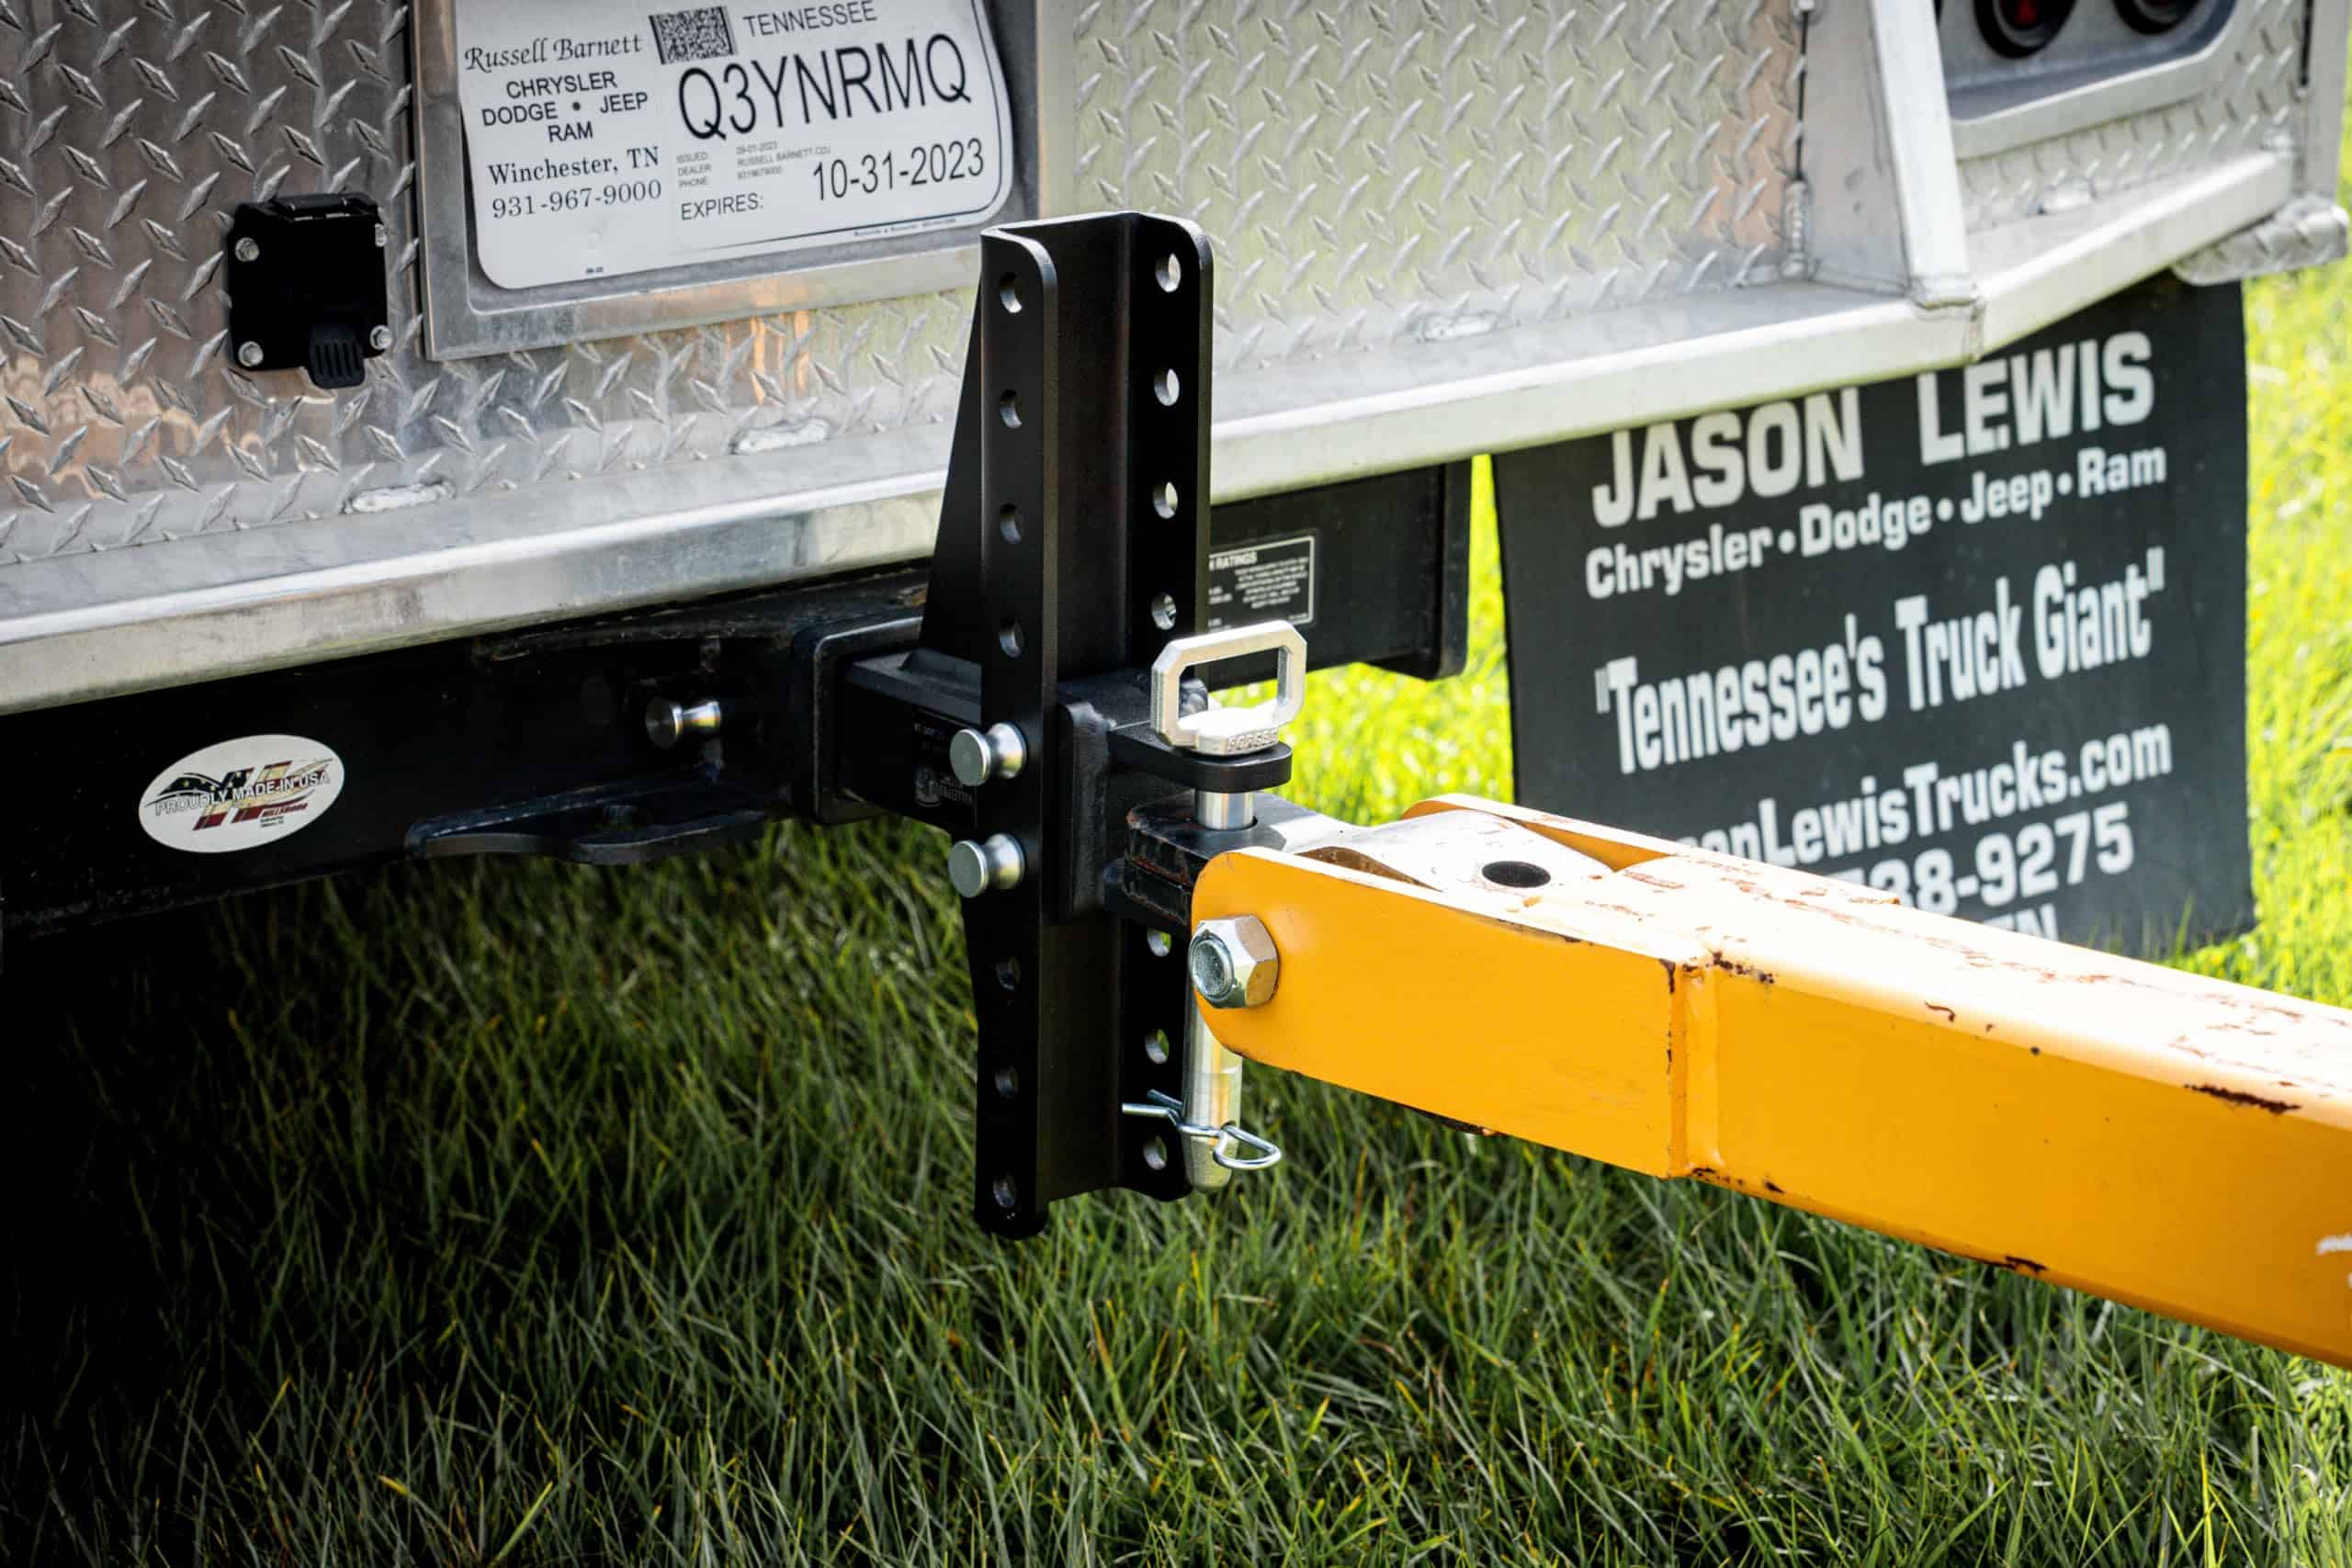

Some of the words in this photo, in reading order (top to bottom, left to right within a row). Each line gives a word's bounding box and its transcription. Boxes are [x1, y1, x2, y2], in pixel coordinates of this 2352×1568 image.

[743, 2, 877, 38] TENNESSEE
[464, 37, 549, 73] Russell
[553, 33, 646, 62] Barnett
[506, 71, 618, 99] CHRYSLER
[678, 33, 971, 141] Q3YNRMQ
[481, 101, 559, 127] DODGE
[599, 92, 649, 114] JEEP
[548, 120, 594, 142] RAM
[488, 158, 618, 186] Winchester,
[627, 146, 660, 169] TN
[681, 191, 764, 220] EXPIRES:
[813, 138, 985, 200] 10-31-2023
[492, 179, 662, 220] 931-967-9000
[1592, 386, 1864, 529] JASON
[1917, 331, 2154, 466] LEWIS
[1586, 523, 1773, 600] Chrysler
[1799, 491, 1932, 551] Dodge
[1960, 469, 2053, 522] Jeep
[2077, 446, 2167, 499] Ram
[1894, 576, 2028, 712] Truck
[154, 790, 230, 817] PROUDLY
[232, 782, 275, 801] MADE
[279, 778, 295, 792] IN
[299, 772, 331, 788] USA
